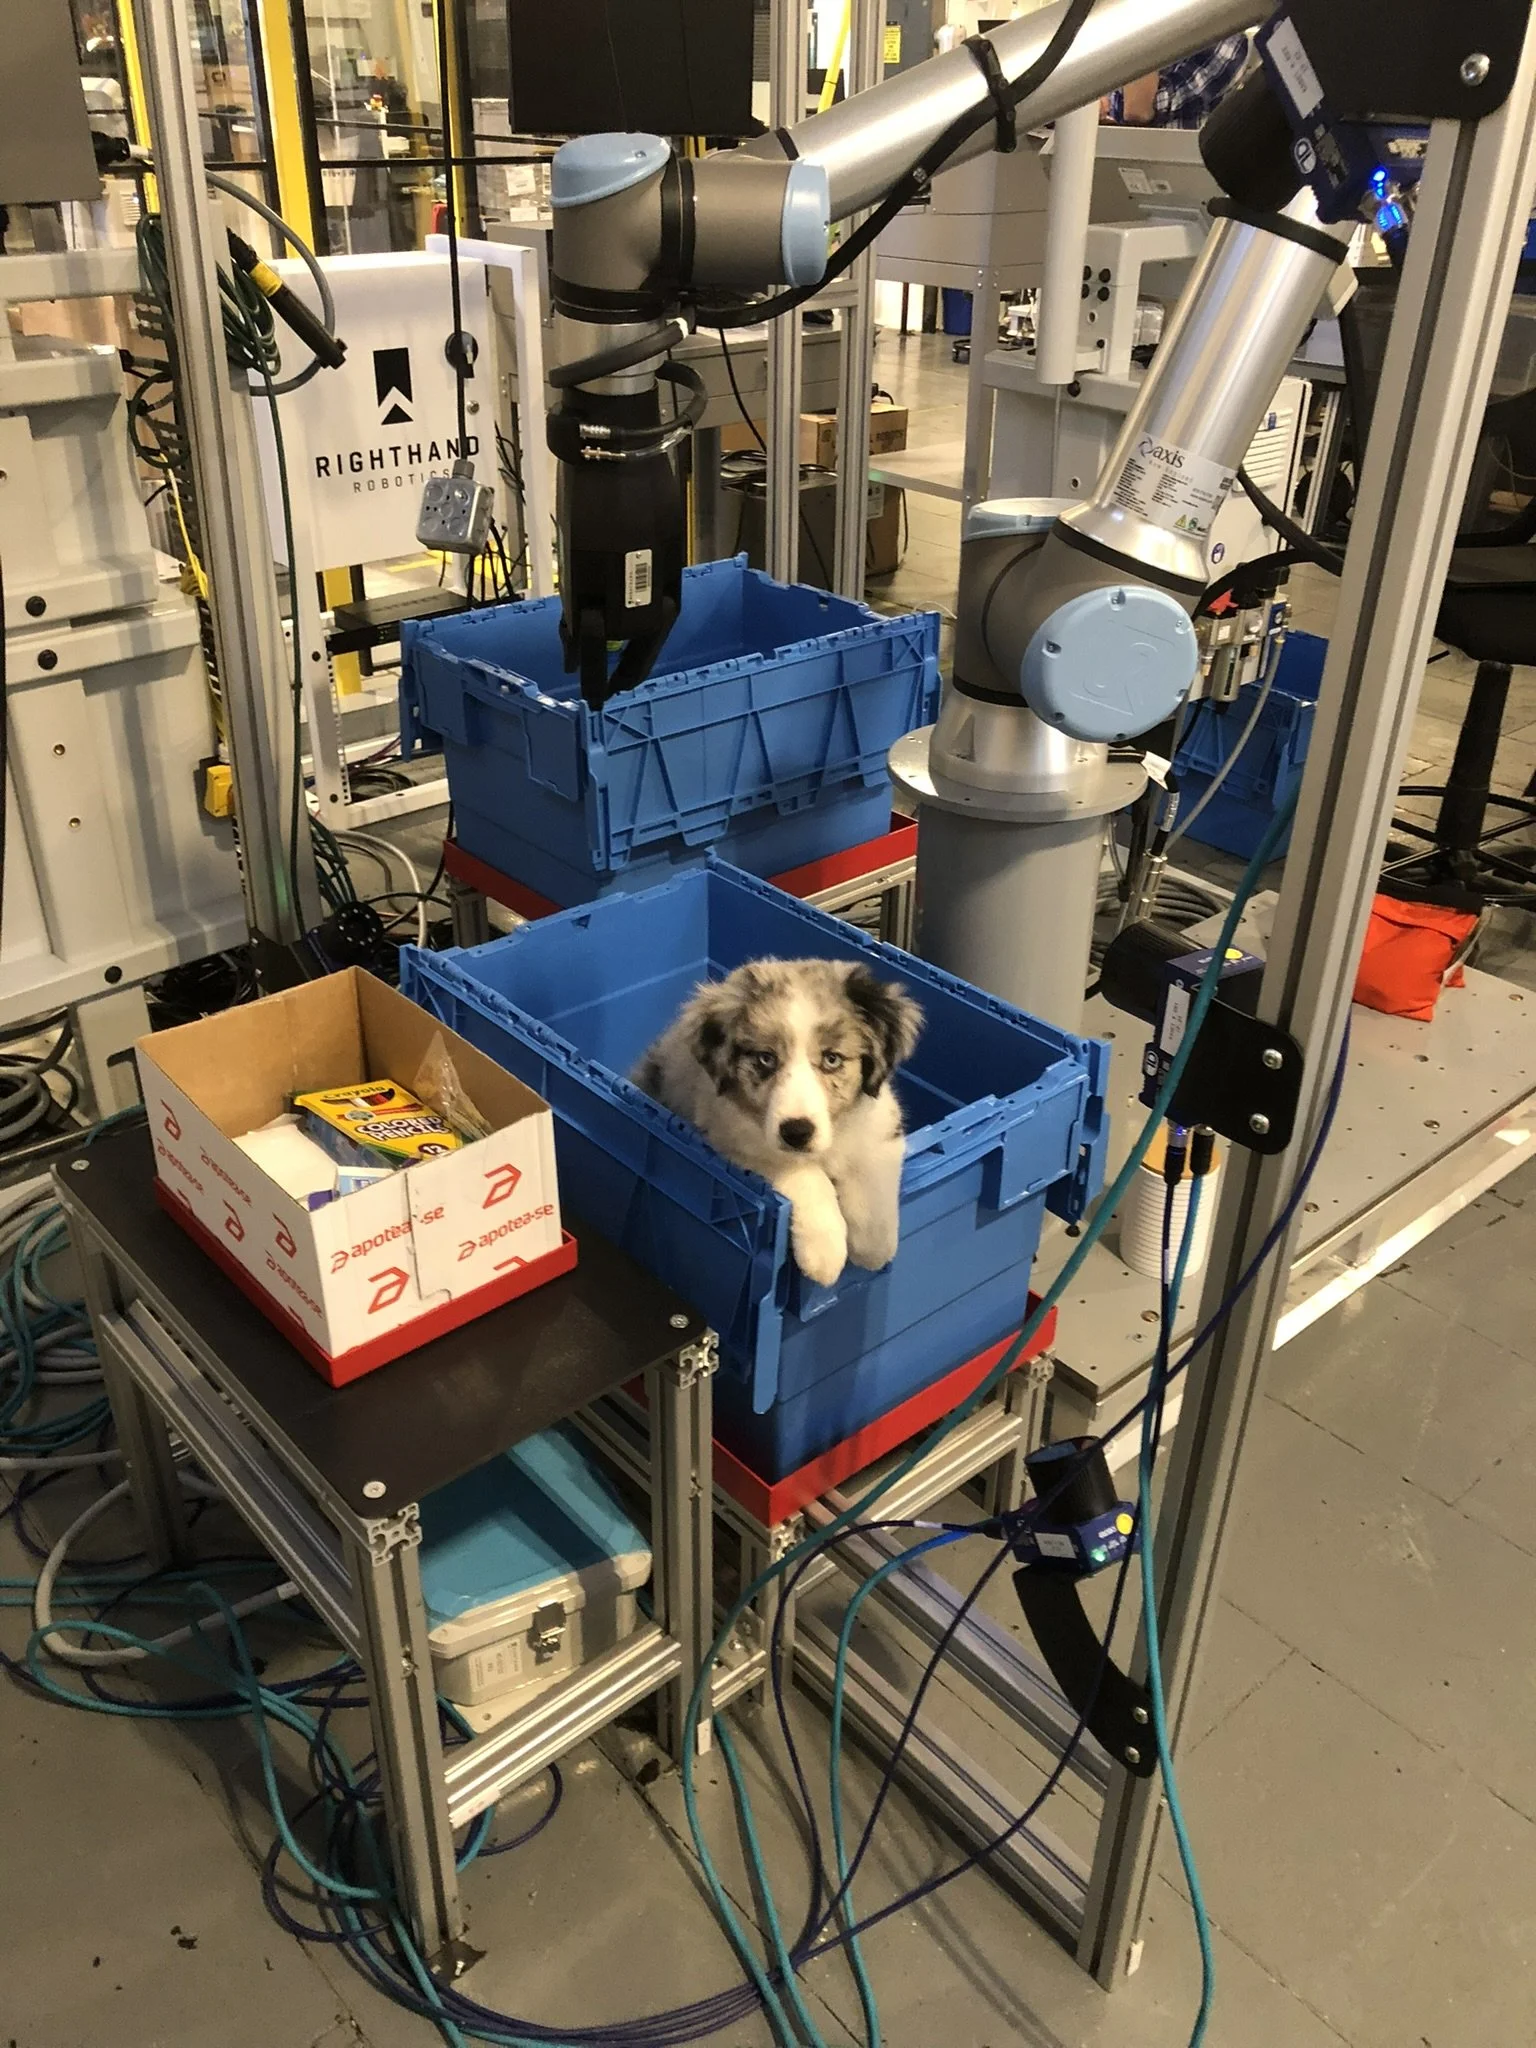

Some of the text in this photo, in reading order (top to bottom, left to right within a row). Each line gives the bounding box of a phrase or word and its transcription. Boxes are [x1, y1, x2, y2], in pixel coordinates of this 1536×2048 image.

[315, 435, 479, 478] RIGHTHAND
[353, 468, 450, 494] ROBOTICS
[356, 1116, 443, 1134] COLORED
[369, 1124, 450, 1141] PENCILS
